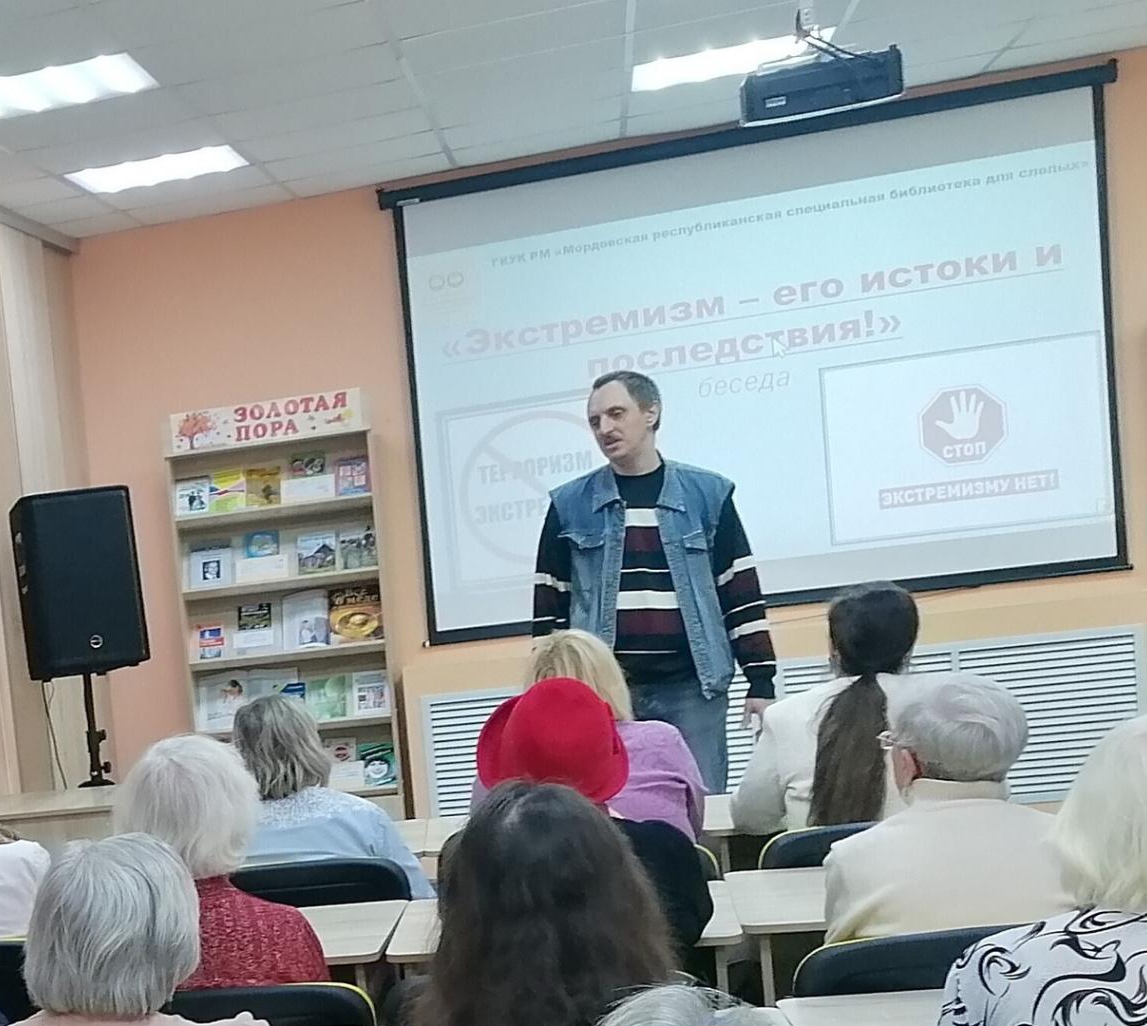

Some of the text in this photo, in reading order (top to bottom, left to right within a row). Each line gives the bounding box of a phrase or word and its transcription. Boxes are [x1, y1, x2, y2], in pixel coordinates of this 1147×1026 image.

[529, 247, 551, 261] РМ
[653, 210, 783, 242] республиканская
[786, 193, 885, 217] специальная
[890, 178, 981, 200] библиотека
[986, 172, 1014, 185] для
[441, 296, 725, 357] «Экстремизм
[773, 277, 844, 306] его
[861, 250, 1017, 293] истоки
[1035, 243, 1062, 267] и
[587, 309, 902, 378] последствия!»
[698, 370, 791, 398] беседа
[233, 391, 347, 423] ЗОЛОТАЯ
[235, 419, 299, 442] ПОРА
[943, 441, 986, 459] СТОП
[881, 473, 1057, 506] ЭКСТРЕМИЗМУ НЕТ!
